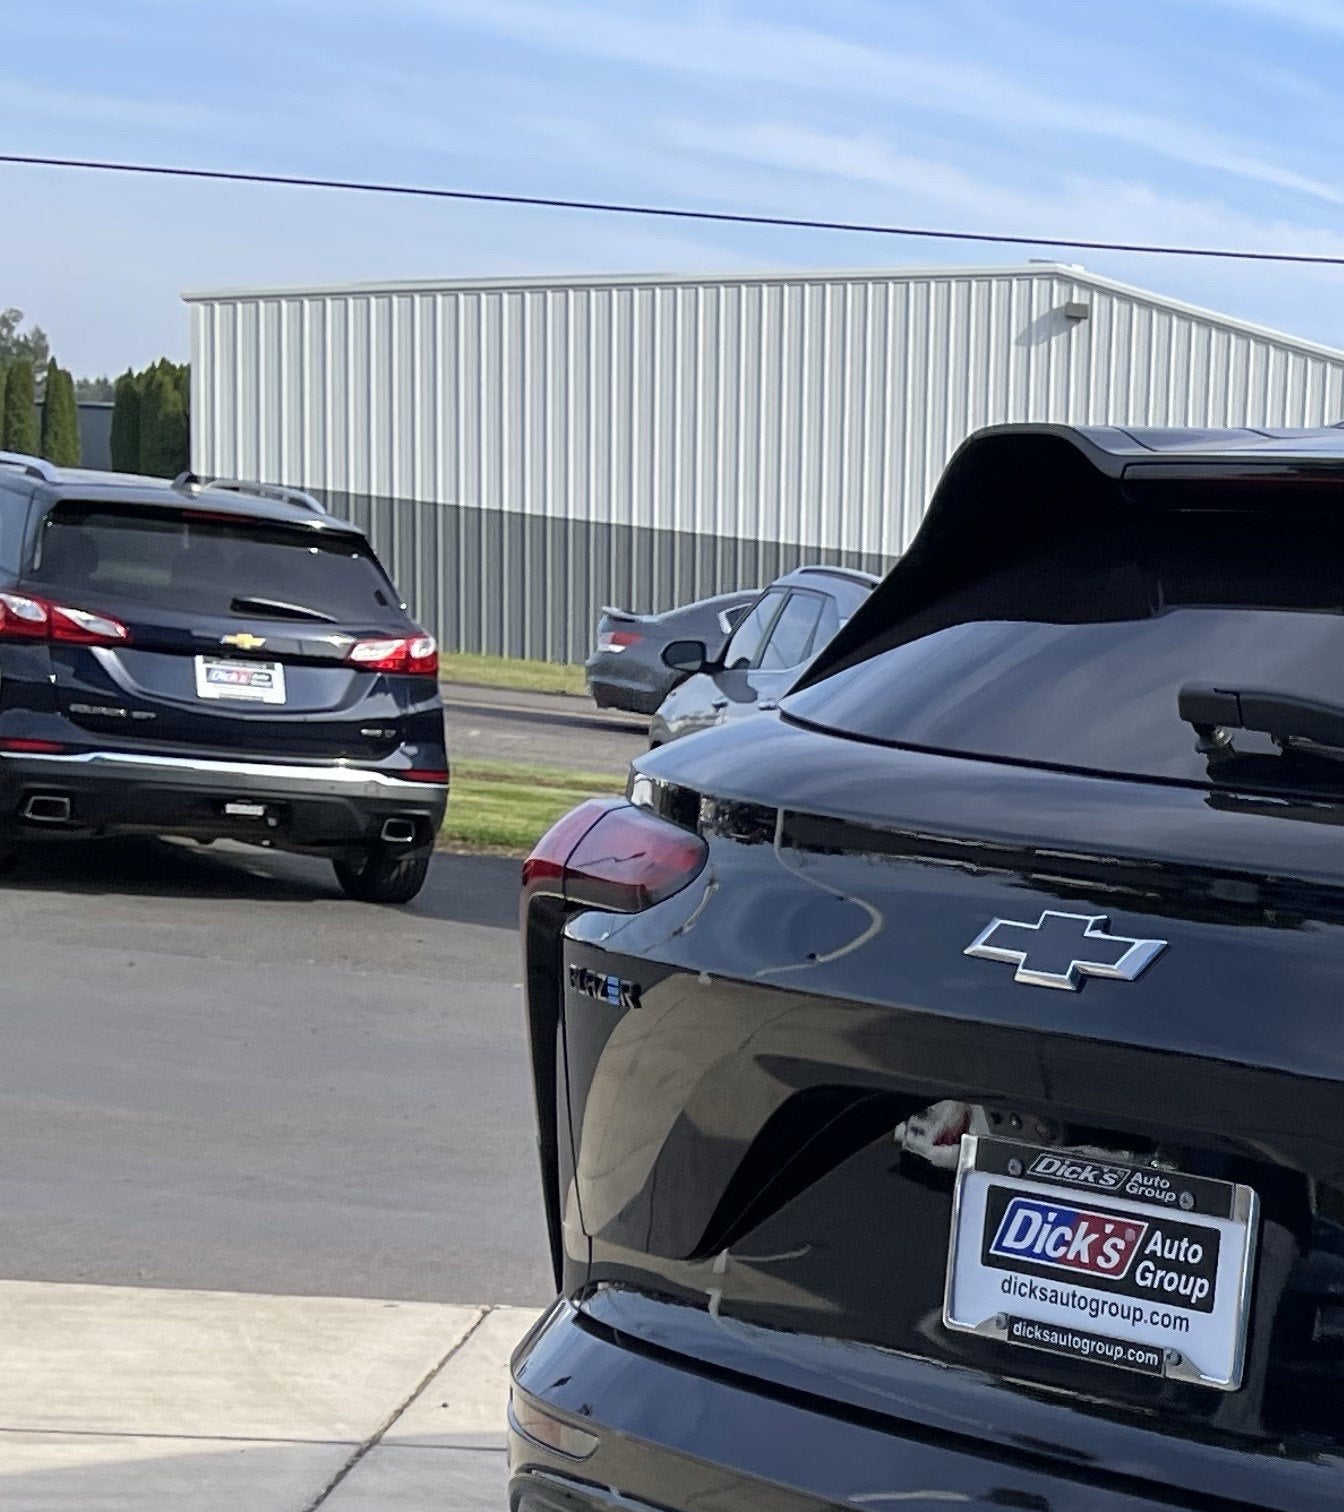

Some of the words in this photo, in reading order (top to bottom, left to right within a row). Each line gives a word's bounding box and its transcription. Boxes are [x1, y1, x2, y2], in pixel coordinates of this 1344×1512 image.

[1034, 1156, 1121, 1187] Dick's
[1129, 1170, 1171, 1190] Auto
[1125, 1180, 1178, 1204] Group
[1001, 1208, 1127, 1270] Dick's
[1144, 1230, 1204, 1265] Auto
[1134, 1260, 1211, 1303] Group
[1000, 1274, 1191, 1333] dicksautogroup.com
[1012, 1318, 1160, 1367] dicksautogroup.com
